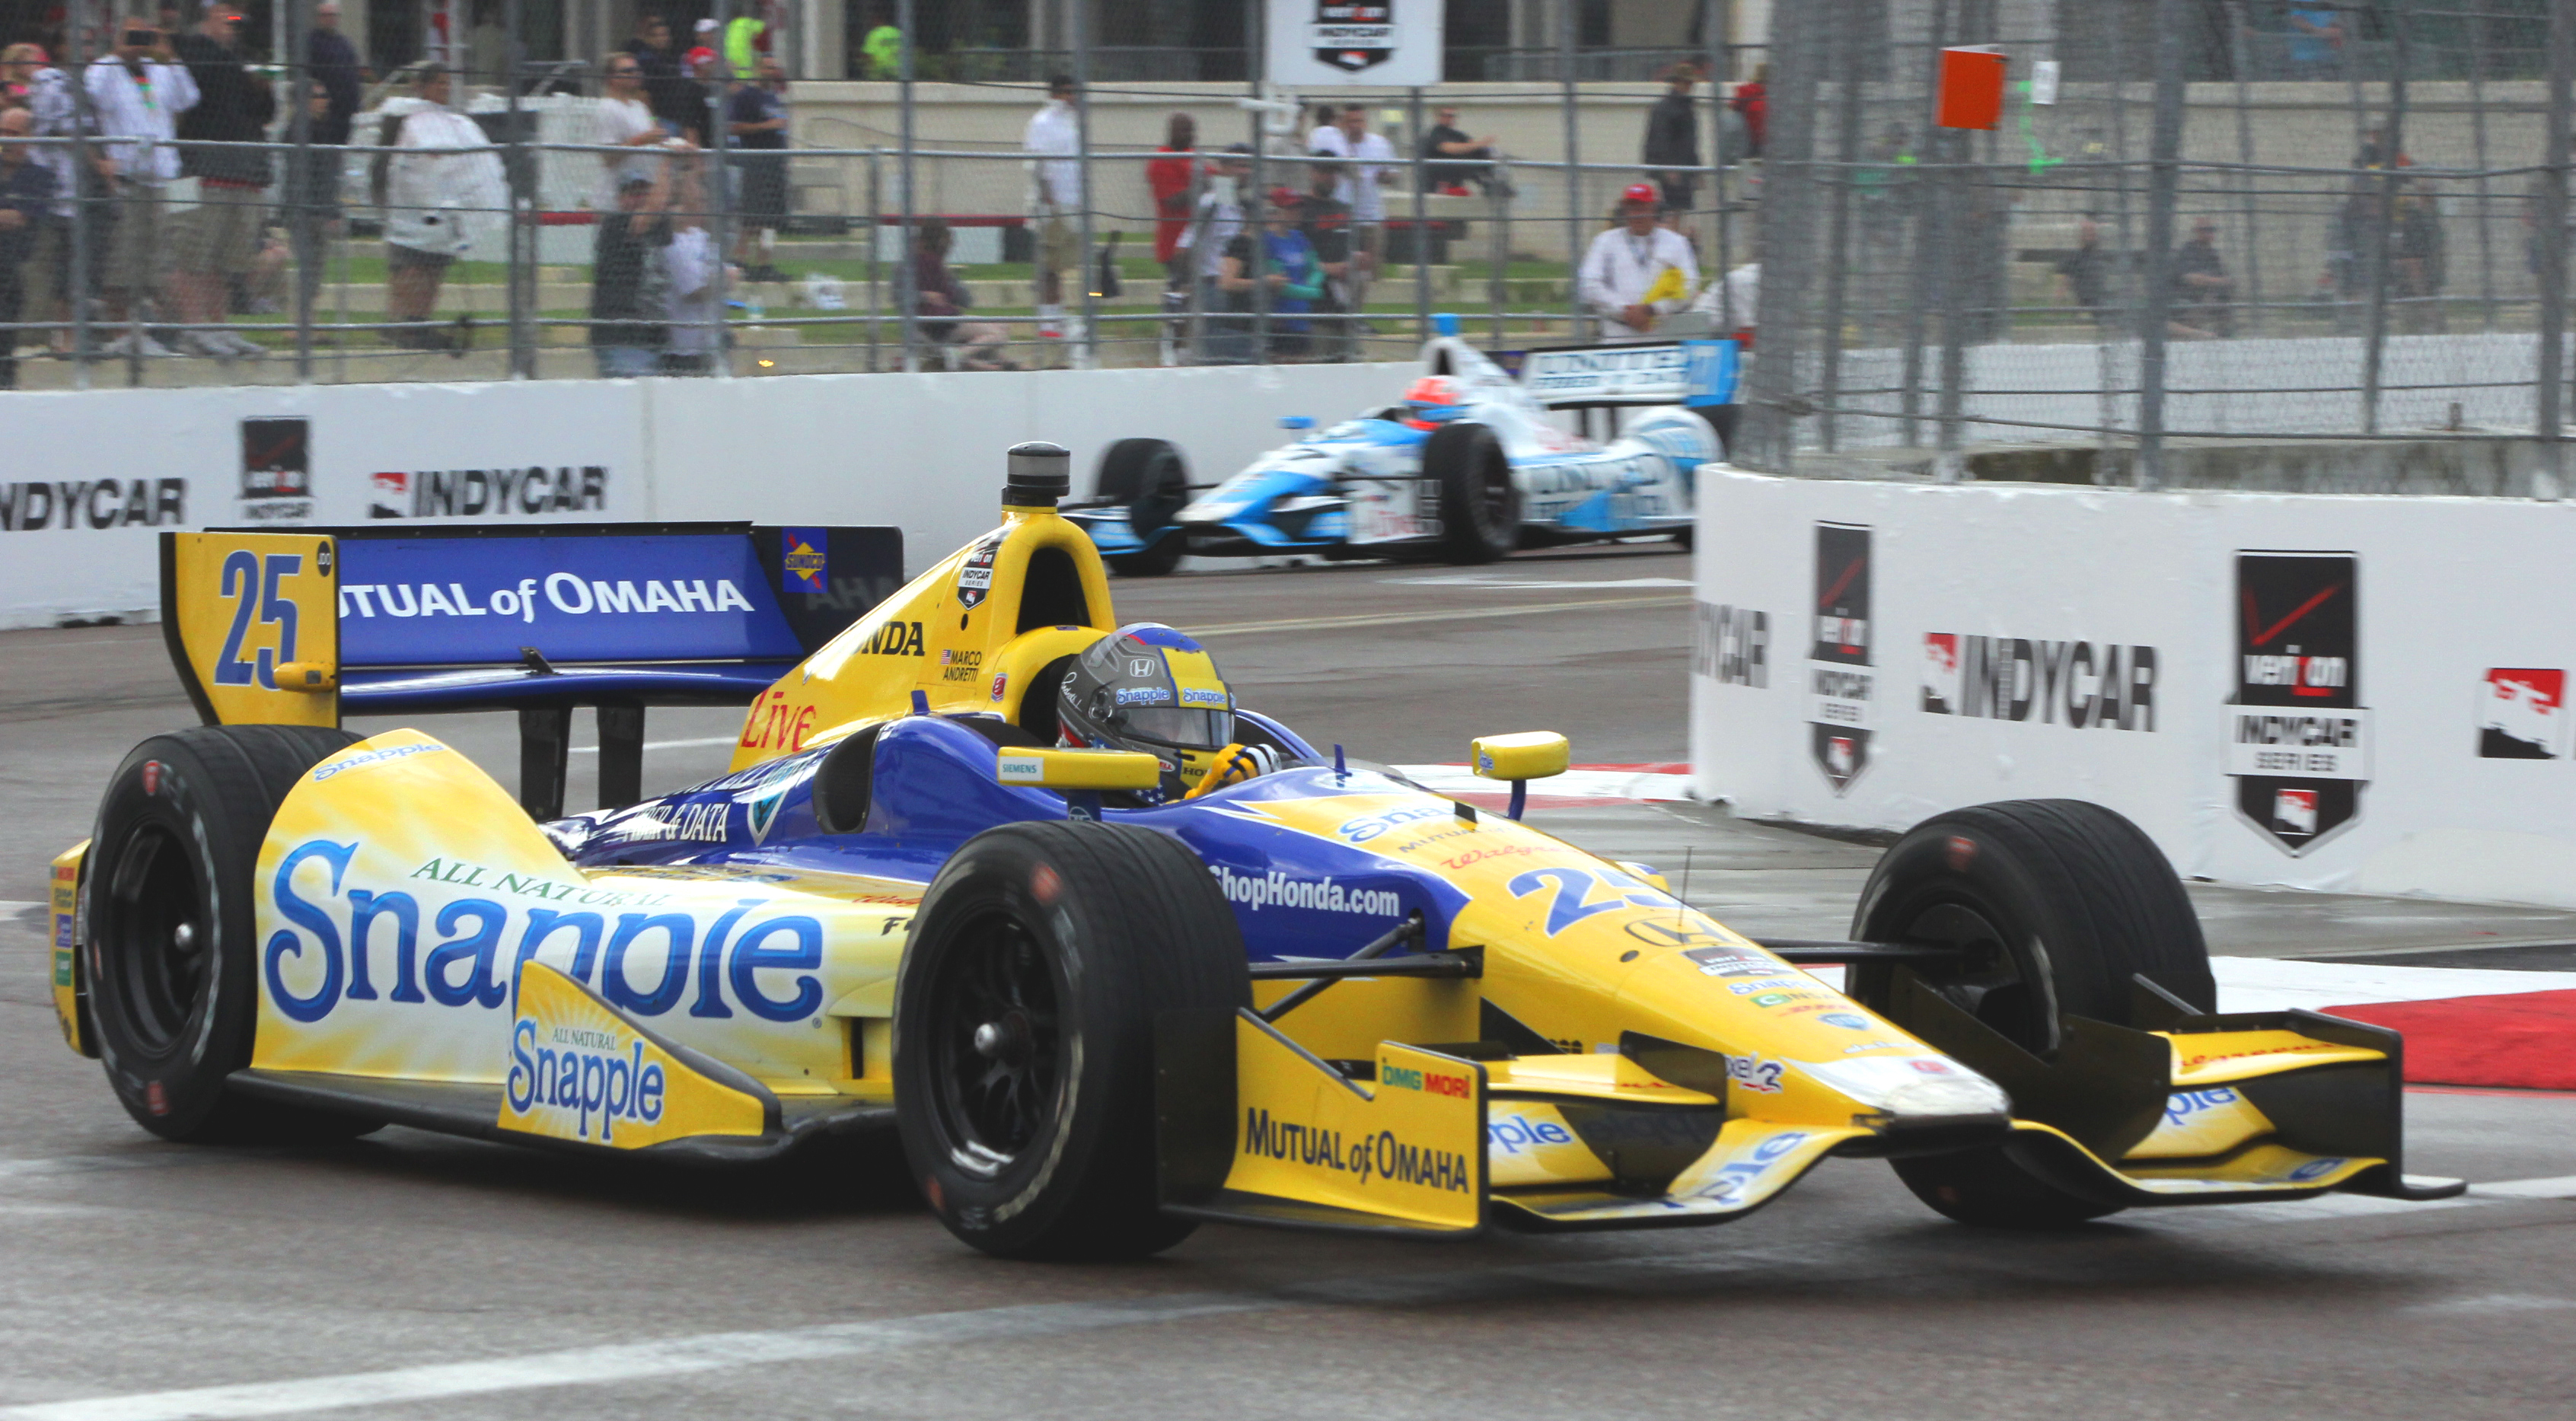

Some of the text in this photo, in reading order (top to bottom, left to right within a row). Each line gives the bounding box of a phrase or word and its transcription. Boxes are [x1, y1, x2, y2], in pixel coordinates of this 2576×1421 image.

[413, 467, 608, 518] INDYCAR
[963, 570, 991, 579] INDYCAR
[490, 578, 537, 623] of
[545, 572, 755, 614] OMAHA
[214, 550, 303, 691] 25
[942, 667, 979, 681] ANDRETTI
[952, 651, 982, 666] MARCO
[2243, 645, 2348, 696] verizon
[1116, 687, 1170, 706] Snapple
[1182, 688, 1226, 706] Snapple
[1962, 634, 2158, 732] INDYCAR
[741, 688, 816, 752] Live
[2235, 715, 2358, 747] INDYCAR
[314, 744, 444, 781] Snapple
[1003, 763, 1037, 774] SIEMENS
[1184, 767, 1208, 776] HO
[2256, 751, 2338, 772] SERIES
[664, 803, 684, 840] &
[679, 803, 732, 843] DATA
[410, 857, 676, 907] ALL NATURAL
[264, 839, 824, 1024] Snapple
[552, 1028, 617, 1050] ALL NATURAL
[507, 1019, 664, 1140] Snapple
[1382, 1066, 1470, 1099] DMG MORI
[1245, 1107, 1470, 1194] MUTUAL of OMAHA
[1489, 1116, 1570, 1154] ple
